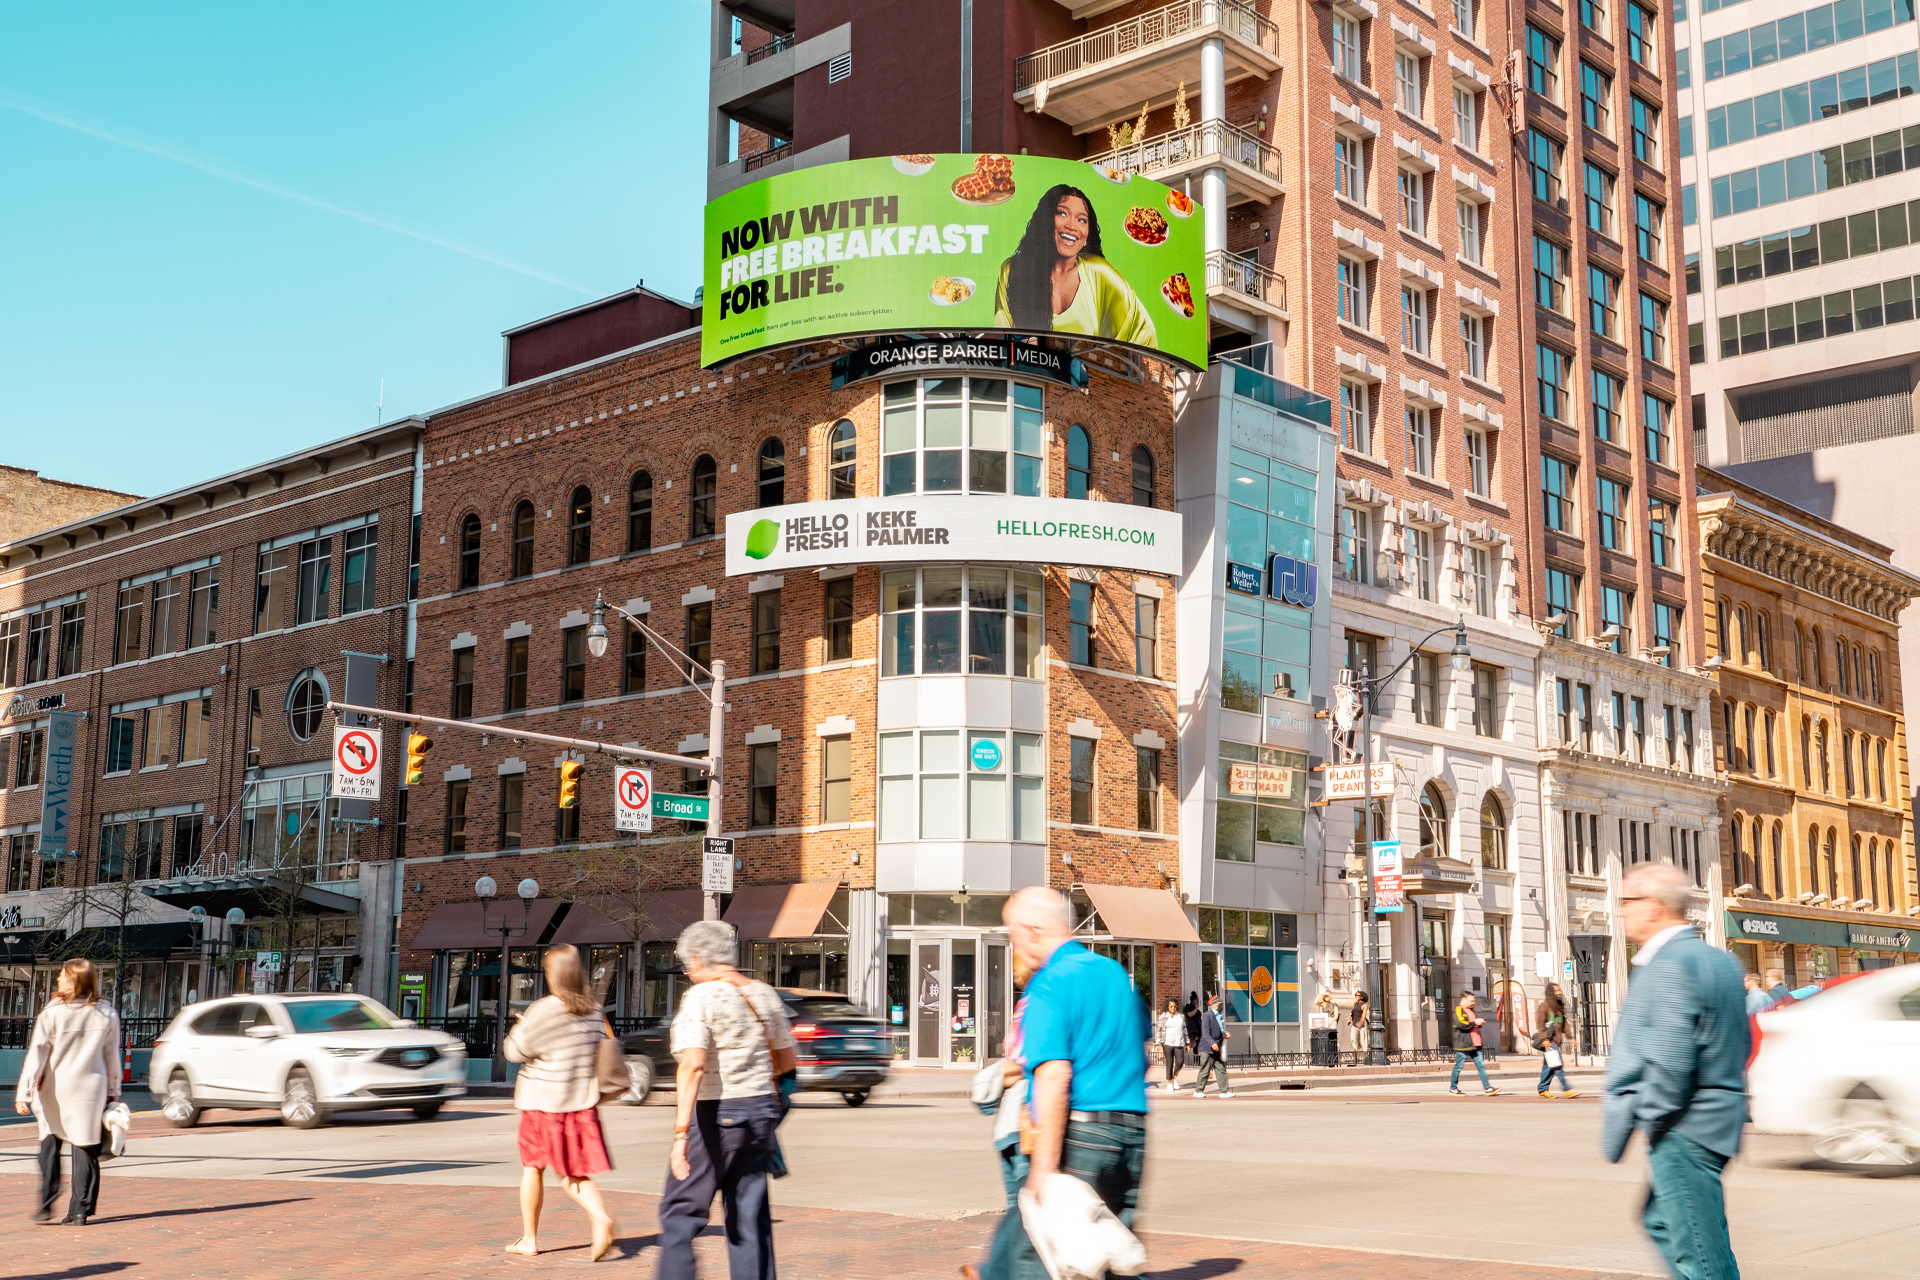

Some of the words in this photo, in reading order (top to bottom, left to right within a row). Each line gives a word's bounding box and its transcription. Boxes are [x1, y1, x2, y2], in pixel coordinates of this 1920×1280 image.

[722, 210, 795, 260] NOW
[799, 195, 899, 235] WITH
[721, 245, 777, 290] FREE
[782, 224, 989, 270] BREAKFAST
[720, 280, 770, 320] FOR
[741, 326, 765, 338] breakfast
[870, 345, 938, 365] ORANGE
[942, 344, 1008, 359] BARREL
[1016, 348, 1060, 369] MEDIA
[786, 514, 848, 535] HELLO
[866, 510, 916, 528] KEKE
[786, 531, 848, 553] FRESH
[866, 528, 949, 546] PALMER
[997, 520, 1155, 546] HELLOFRESH.COM
[1233, 568, 1254, 580] Robert
[1233, 576, 1252, 588] Weiler
[1280, 709, 1311, 734] Werth
[46, 746, 72, 808] Werth
[1329, 766, 1384, 781] PLANTRS
[664, 800, 693, 814] Broad
[175, 862, 209, 879] NORTH
[211, 852, 228, 879] 10
[228, 860, 255, 876] HIGH
[1851, 933, 1868, 944] BANK
[1869, 935, 1875, 944] OF
[1876, 936, 1900, 946] AMERICA
